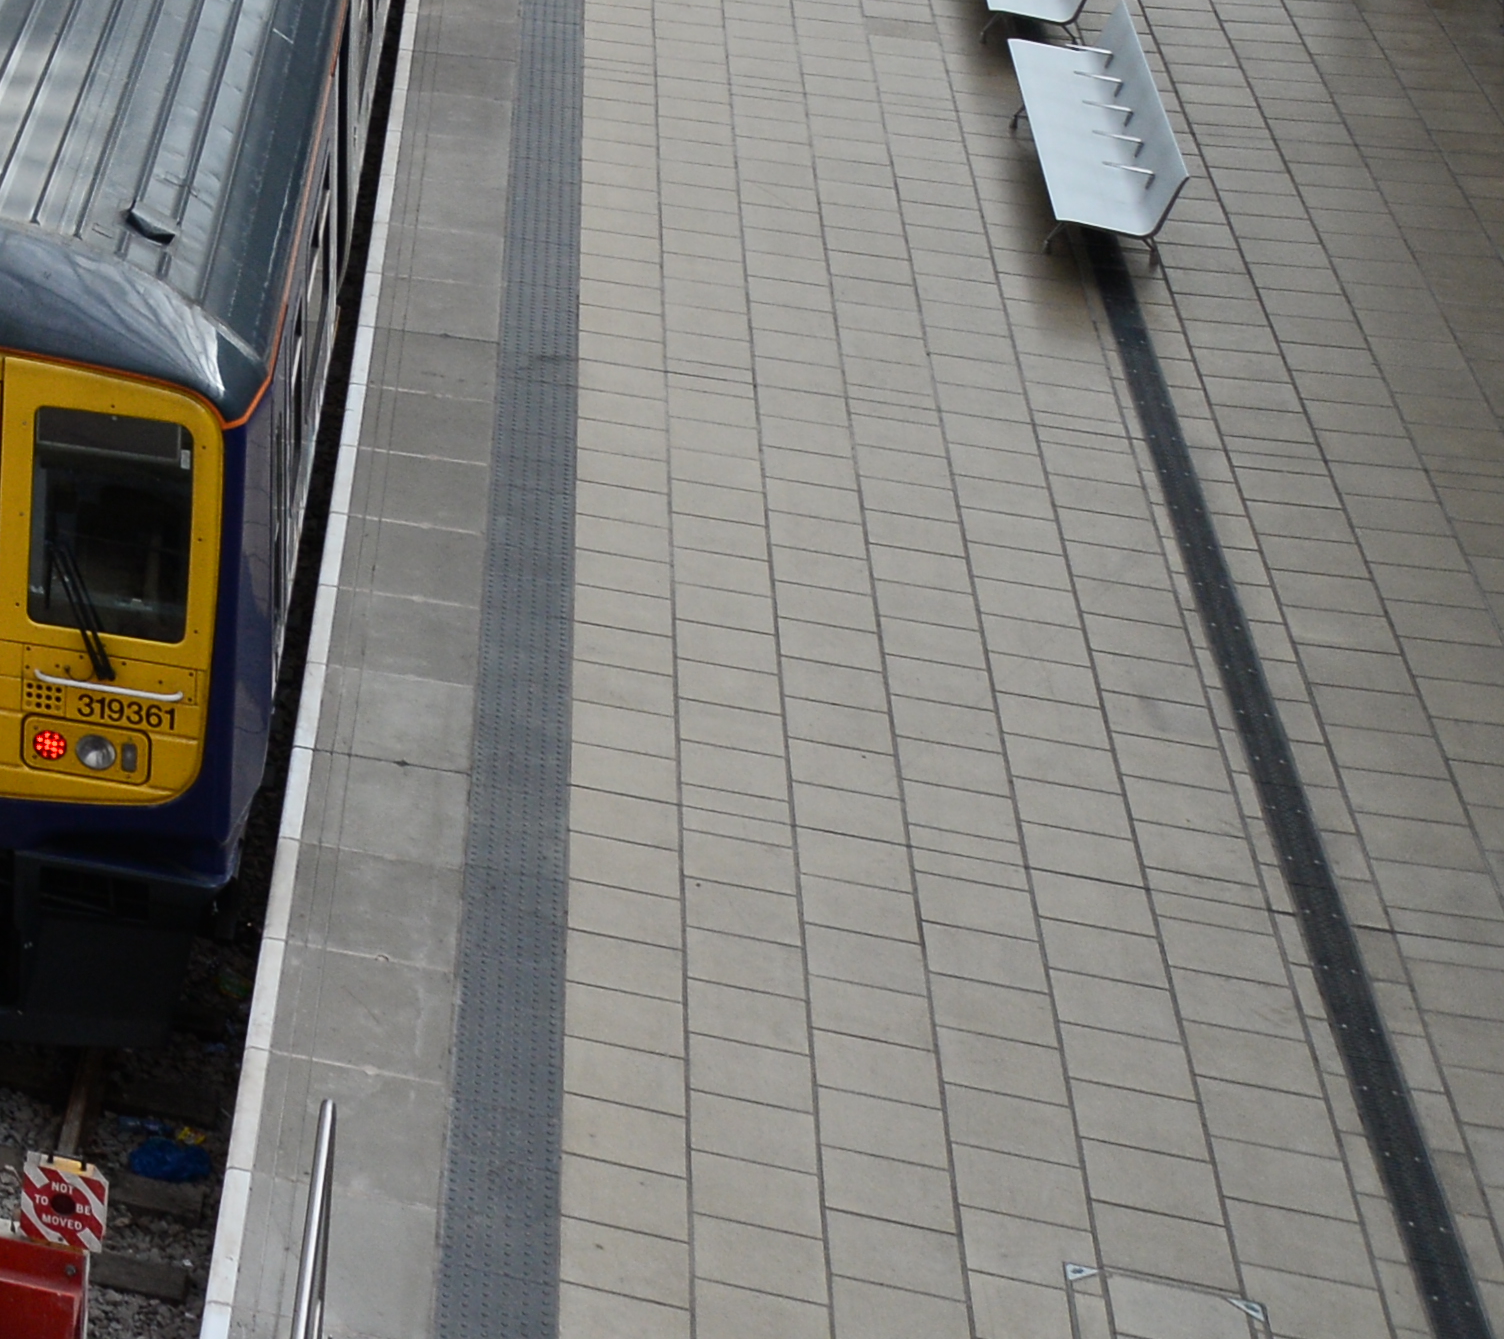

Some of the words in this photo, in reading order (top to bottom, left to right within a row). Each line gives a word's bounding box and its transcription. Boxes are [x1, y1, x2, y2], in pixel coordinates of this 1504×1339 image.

[77, 693, 176, 731] 319361
[51, 1181, 74, 1195] NOT
[34, 1193, 49, 1206] TO
[75, 1203, 92, 1216] BE
[41, 1213, 83, 1230] MOVED
